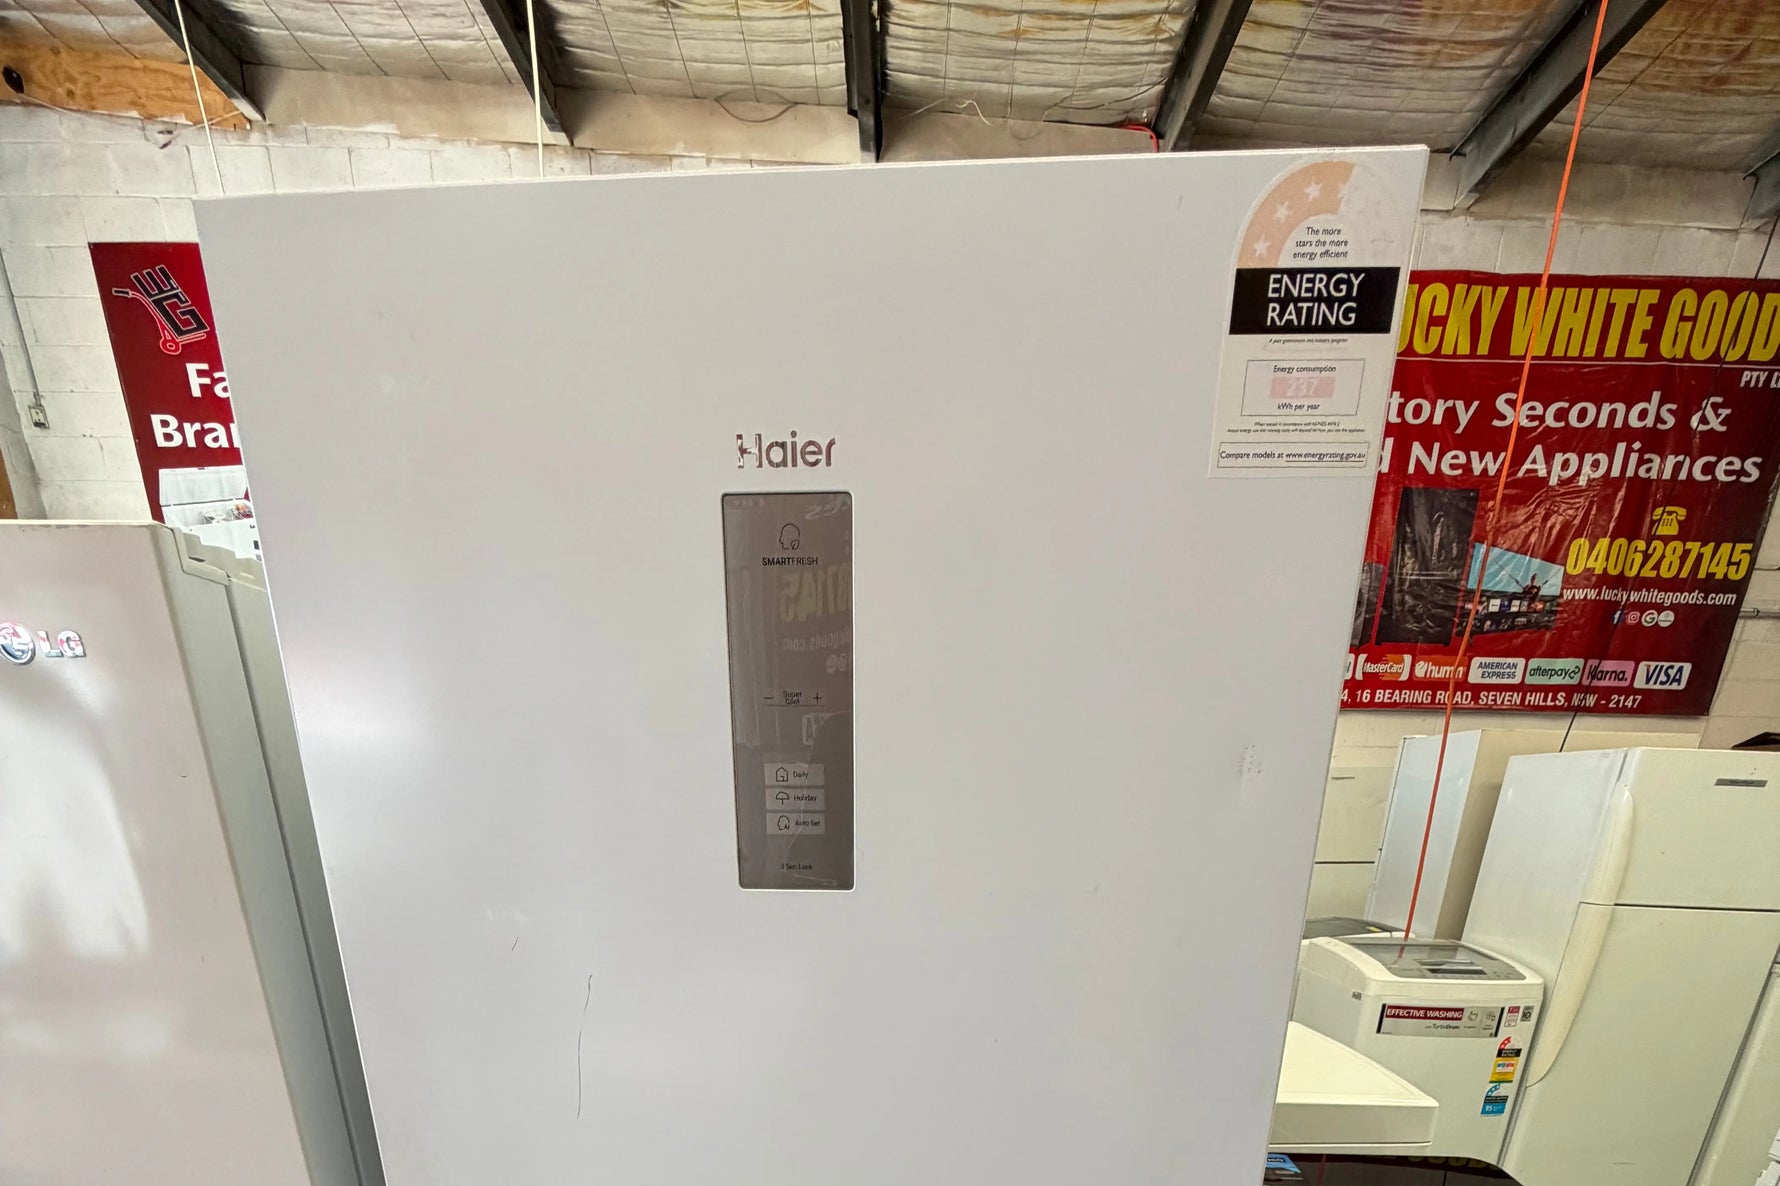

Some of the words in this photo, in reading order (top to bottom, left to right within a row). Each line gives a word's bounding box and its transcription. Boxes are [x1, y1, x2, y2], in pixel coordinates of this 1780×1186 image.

[1306, 227, 1320, 235] The
[1314, 239, 1327, 247] the
[1293, 252, 1318, 261] energy
[1320, 250, 1349, 258] efficient
[1267, 273, 1366, 298] ENERGY
[1266, 302, 1357, 326] RATING
[1509, 285, 1657, 358] WHITE
[1659, 287, 1780, 362] GOOD
[1273, 365, 1295, 374] Energy
[1296, 365, 1337, 374] consumption
[1740, 370, 1769, 388] PTY
[1286, 379, 1318, 397] 237
[1294, 403, 1305, 411] per
[1306, 403, 1320, 411] year
[1491, 390, 1678, 432] Seconds
[1689, 396, 1732, 432] &
[736, 430, 836, 469] Haier
[1219, 451, 1250, 460] Compare
[1252, 450, 1276, 459] models
[1285, 451, 1366, 461] www.energyrating.gov.au
[1407, 441, 1506, 477] New
[1516, 441, 1763, 487] Appliances
[762, 557, 819, 567] SMARTFRESH
[1566, 538, 1753, 580] 0406287145
[1562, 585, 1737, 606] www.luckywhitegoods.com
[37, 630, 87, 658] LG
[1363, 660, 1404, 674] MasterCard
[1477, 662, 1518, 671] AMERICAN
[1529, 665, 1569, 680] afterpay
[1480, 671, 1517, 680] EXPRESS
[1644, 664, 1684, 686] VISA
[782, 691, 802, 699] Super
[1356, 689, 1371, 703] 16
[1374, 689, 1433, 704] BEARING
[1479, 691, 1523, 705] SEVEN
[1525, 692, 1569, 707] HILLS,
[1608, 694, 1643, 709] 2147
[792, 771, 809, 779] Daily
[793, 795, 818, 803] Holiday
[809, 819, 821, 827] Set
[1387, 1008, 1425, 1017] EFFECTIVE
[1426, 1010, 1463, 1019] WASHING
